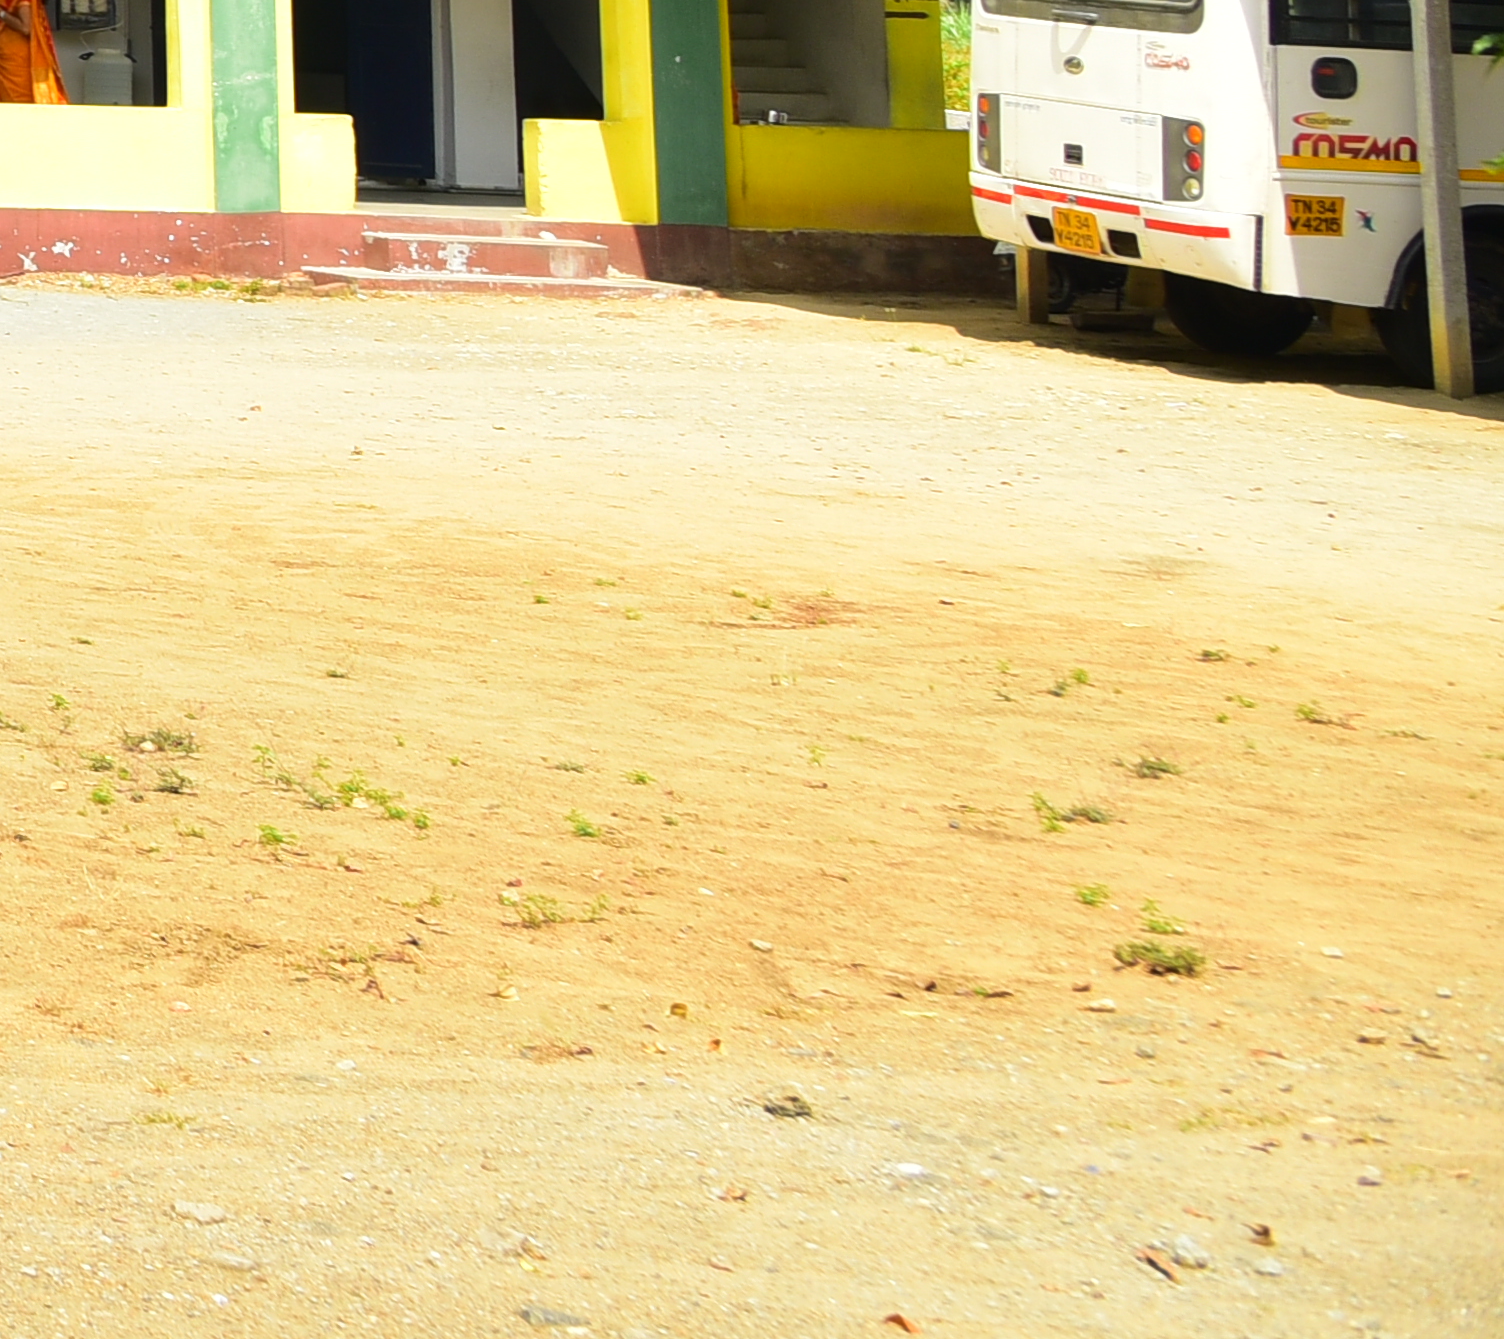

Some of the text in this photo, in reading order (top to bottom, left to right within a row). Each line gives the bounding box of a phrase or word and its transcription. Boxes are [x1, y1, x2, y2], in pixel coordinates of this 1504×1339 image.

[1304, 116, 1353, 126] tourister
[1292, 132, 1418, 162] COSMO
[1315, 199, 1337, 216] 34
[1074, 214, 1091, 232] 34
